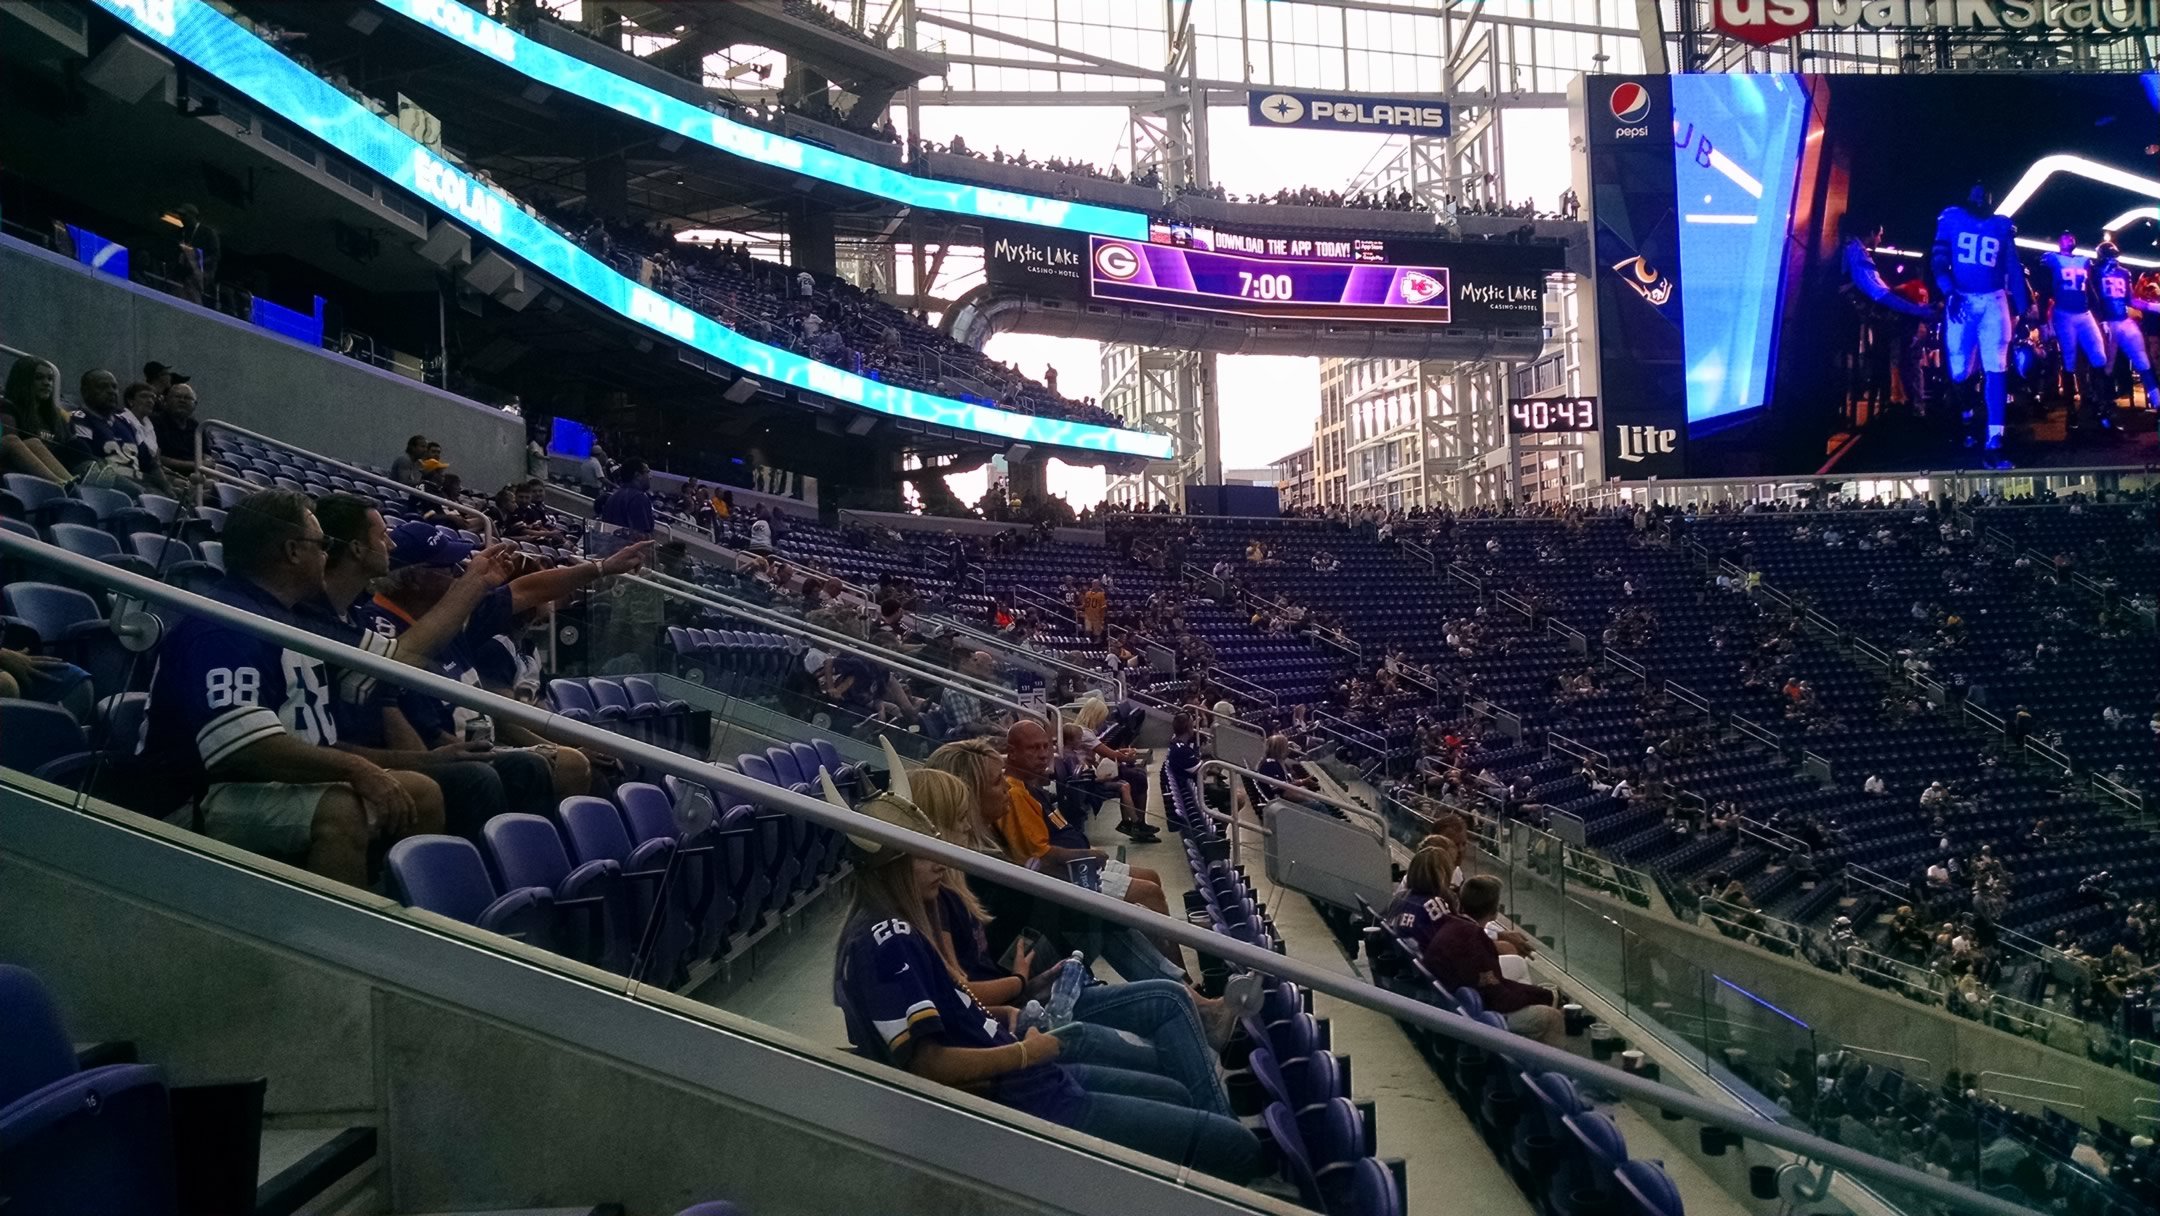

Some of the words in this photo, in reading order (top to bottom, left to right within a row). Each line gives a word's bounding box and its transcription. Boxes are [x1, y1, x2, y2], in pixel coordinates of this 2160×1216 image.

[1312, 101, 1444, 127] POLARIS
[1616, 126, 1648, 139] pepsi
[414, 148, 502, 235] ECOLAB
[1216, 232, 1264, 254] DOWNLOAD
[1267, 240, 1287, 255] THE
[1291, 240, 1311, 256] APP
[1315, 241, 1350, 257] TODAY!
[1957, 232, 1999, 267] 98
[1027, 266, 1053, 275] CASINO
[2061, 267, 2088, 291] 97
[1239, 272, 1292, 300] 7:00
[1513, 401, 1593, 429] 40:43
[1617, 425, 1677, 463] Lite
[206, 666, 261, 710] 88
